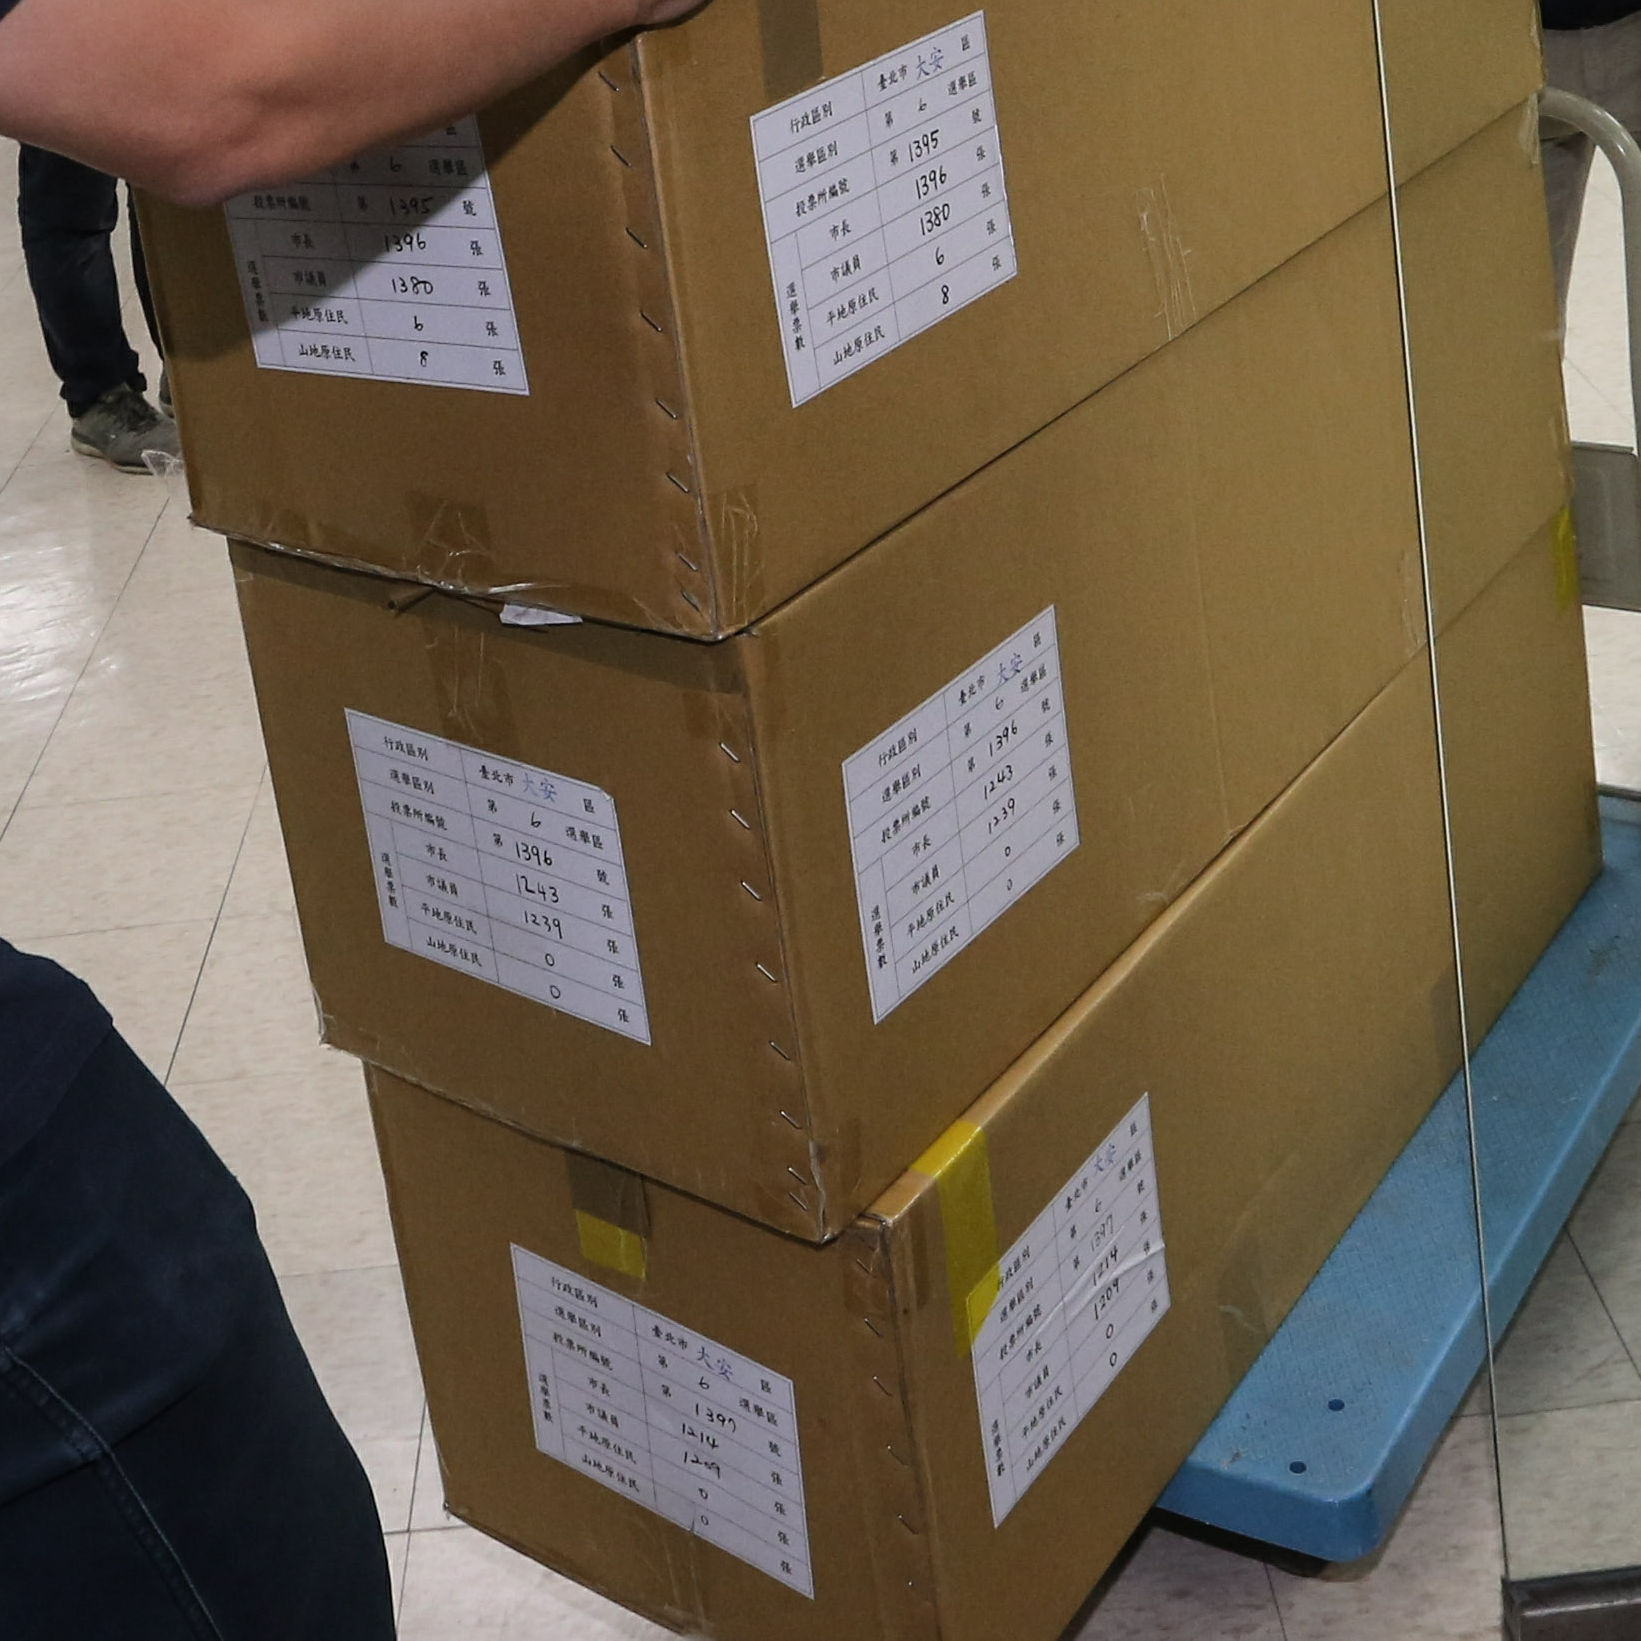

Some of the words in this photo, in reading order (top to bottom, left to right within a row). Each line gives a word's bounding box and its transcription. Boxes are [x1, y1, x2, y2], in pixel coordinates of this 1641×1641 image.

[789, 100, 831, 132] 行政區別
[877, 64, 906, 90] 臺北市
[915, 46, 942, 79] 大安
[794, 140, 836, 172] 選舉區別
[947, 70, 976, 94] 選舉區
[795, 177, 849, 216] 投票所編號
[908, 128, 938, 161] 1395
[829, 218, 850, 240] 市長
[915, 164, 946, 199] 1396
[829, 253, 860, 281] 市議員
[919, 202, 949, 235] 1380
[786, 281, 804, 350] 選舉票數
[826, 286, 878, 325] 平地原住民
[833, 324, 884, 364] 山地原住民
[940, 283, 948, 304] 8
[383, 735, 427, 760] 行政區別
[478, 764, 512, 785] 臺北市
[389, 768, 433, 794] 選舉區別
[530, 811, 541, 827] 6
[564, 825, 602, 849] 選舉區
[390, 800, 446, 830] 投票所編號
[515, 841, 551, 865] 1396
[424, 842, 447, 861] 市長
[515, 873, 558, 902] 1243
[425, 874, 457, 896] 市議員
[523, 910, 562, 938] 1239
[420, 902, 476, 934] 平地原住民
[544, 952, 554, 966] 0
[426, 935, 481, 966] 山地原住民
[548, 984, 560, 998] 0
